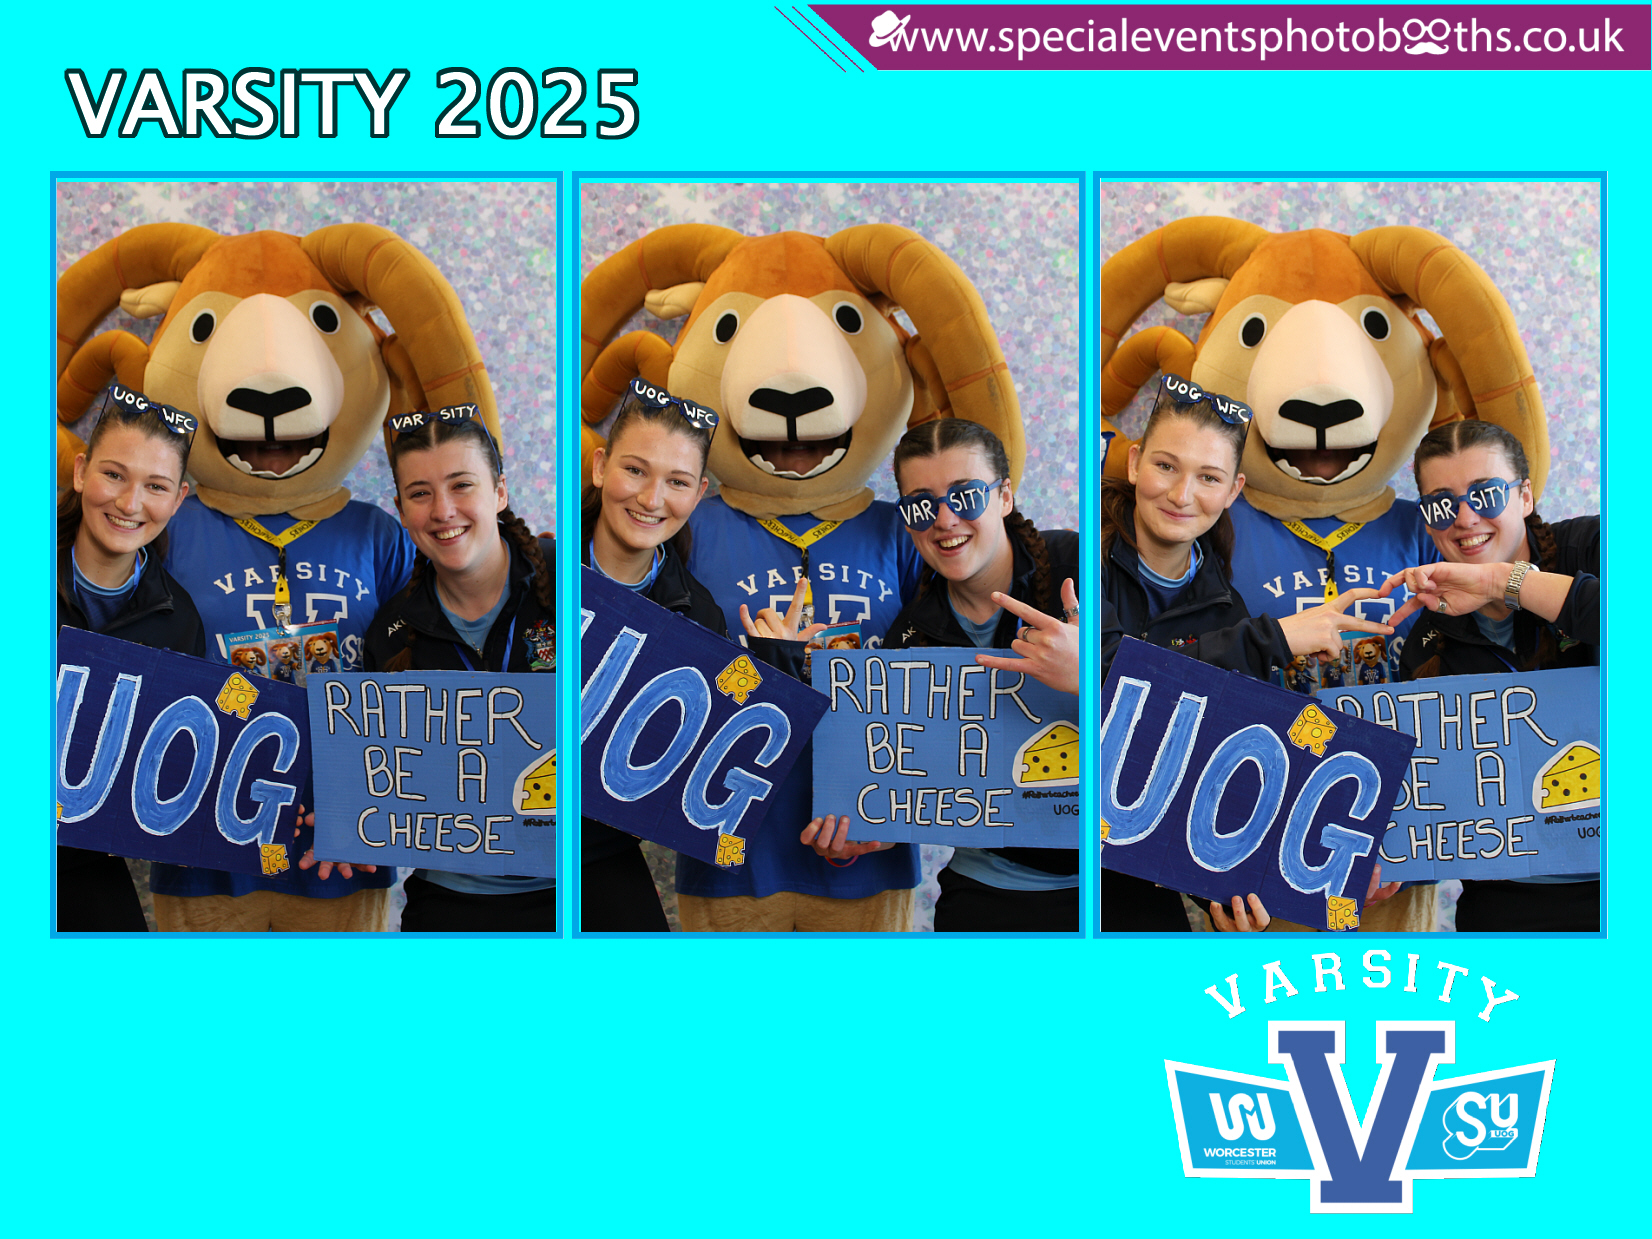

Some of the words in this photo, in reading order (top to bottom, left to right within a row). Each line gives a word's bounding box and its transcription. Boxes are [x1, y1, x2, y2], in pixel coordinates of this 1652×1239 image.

[114, 386, 149, 410] UOG
[162, 407, 194, 431] WFC
[392, 413, 424, 430] VAR
[440, 404, 476, 420] SITY
[634, 380, 670, 405] UOG
[683, 402, 716, 426] WFC
[1166, 376, 1202, 400] UOG
[1216, 397, 1249, 422] WFC
[899, 499, 937, 526] VAR
[949, 485, 987, 512] SITY
[1420, 498, 1457, 525] VAR
[1469, 483, 1507, 511] SITY
[229, 634, 254, 643] VARSITY
[325, 679, 542, 750] RATHER
[829, 656, 1042, 724] RATHER
[57, 664, 300, 847] UOG
[364, 745, 427, 802] BE
[457, 747, 488, 803] A
[865, 722, 928, 777] BE
[958, 723, 989, 777] A
[1101, 676, 1382, 897] UOG
[1475, 750, 1506, 807] A
[857, 783, 1014, 827] CHEESE
[357, 806, 515, 855] CHEESE
[1378, 815, 1539, 864] CHEESE
